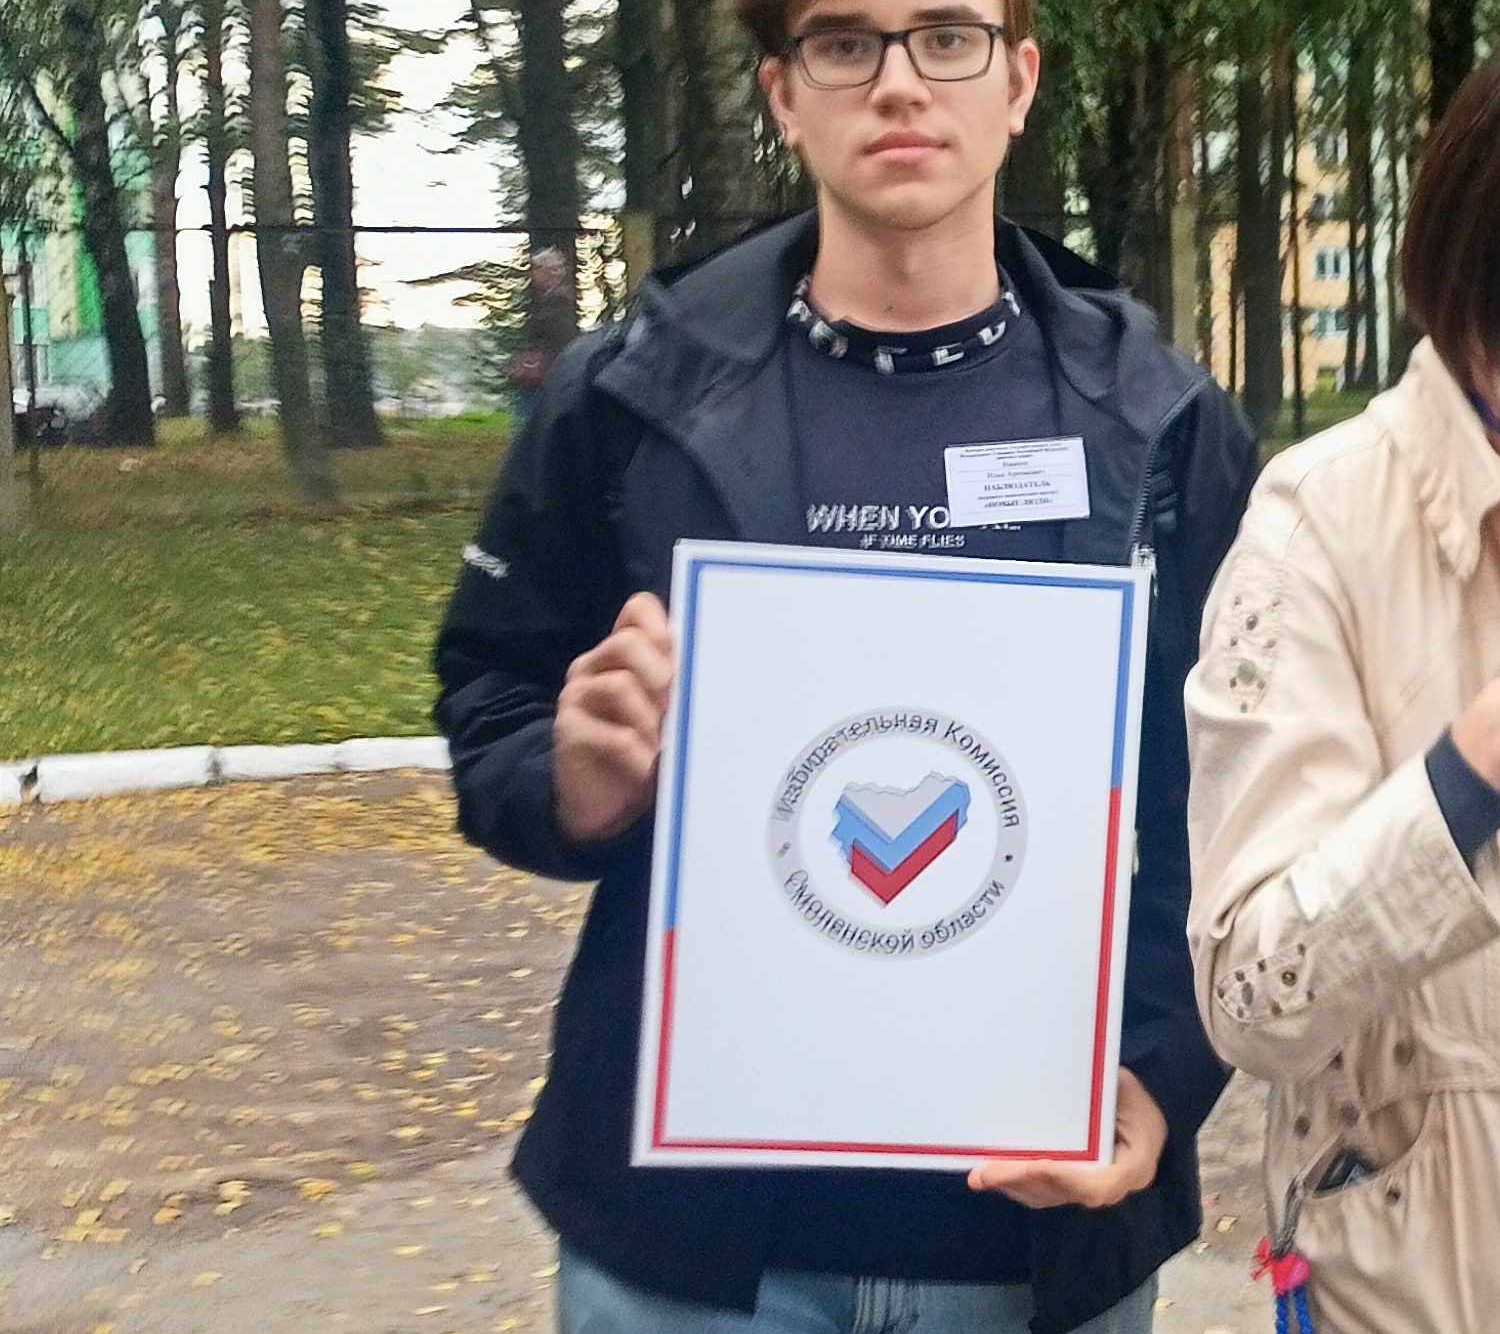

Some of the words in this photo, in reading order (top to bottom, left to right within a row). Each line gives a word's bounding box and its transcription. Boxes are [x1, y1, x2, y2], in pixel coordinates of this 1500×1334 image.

[806, 504, 899, 532] WHEN
[908, 506, 951, 529] YO
[881, 534, 917, 549] TIME
[919, 534, 966, 549] FLIES
[944, 720, 1020, 827] Комиссия
[784, 869, 914, 954] Смоленской
[920, 879, 1005, 950] области
